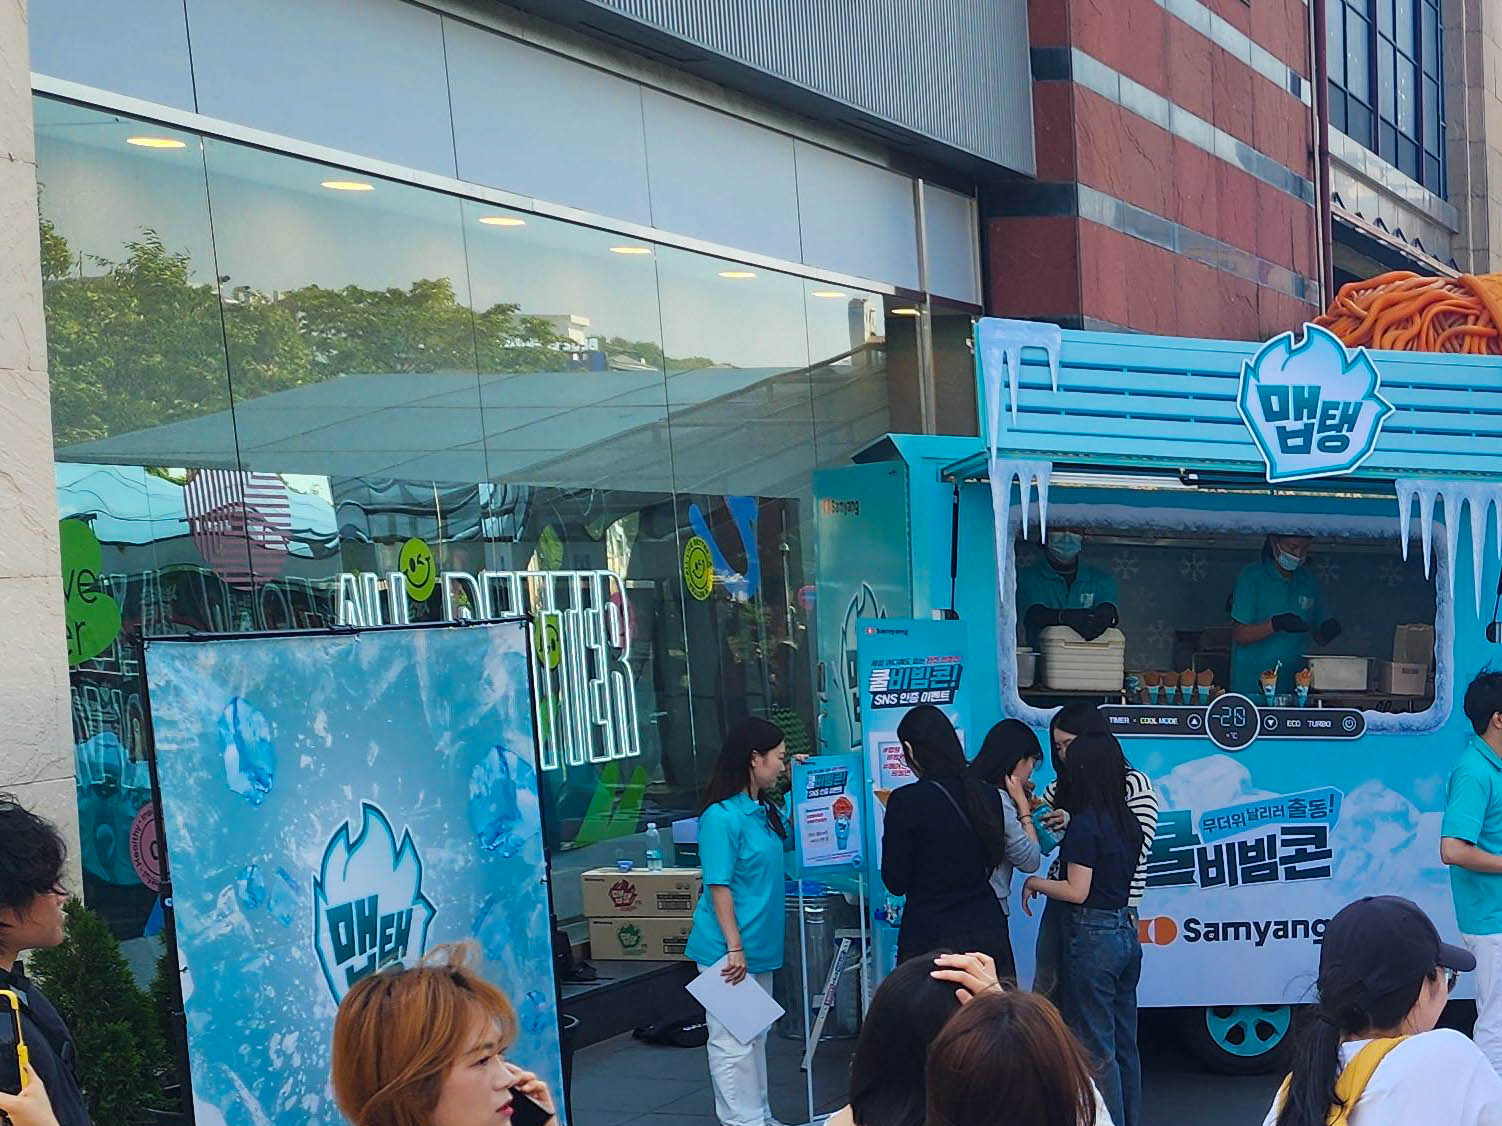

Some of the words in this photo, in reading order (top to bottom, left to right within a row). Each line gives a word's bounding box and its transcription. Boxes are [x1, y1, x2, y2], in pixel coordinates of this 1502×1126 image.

[1256, 383, 1363, 456] 맵탱
[869, 664, 961, 692] 쿨비빔콘!
[873, 693, 899, 706] SNS
[920, 689, 951, 703] 이벤트
[1139, 717, 1158, 725] COOL
[1158, 717, 1179, 725] MODE
[1286, 720, 1301, 728] ECO
[1307, 720, 1332, 728] TURBO
[1202, 811, 1246, 833] 무더위
[1246, 803, 1286, 823] 날리러
[1287, 793, 1335, 820] 출동!
[1183, 917, 1329, 947] Samyang
